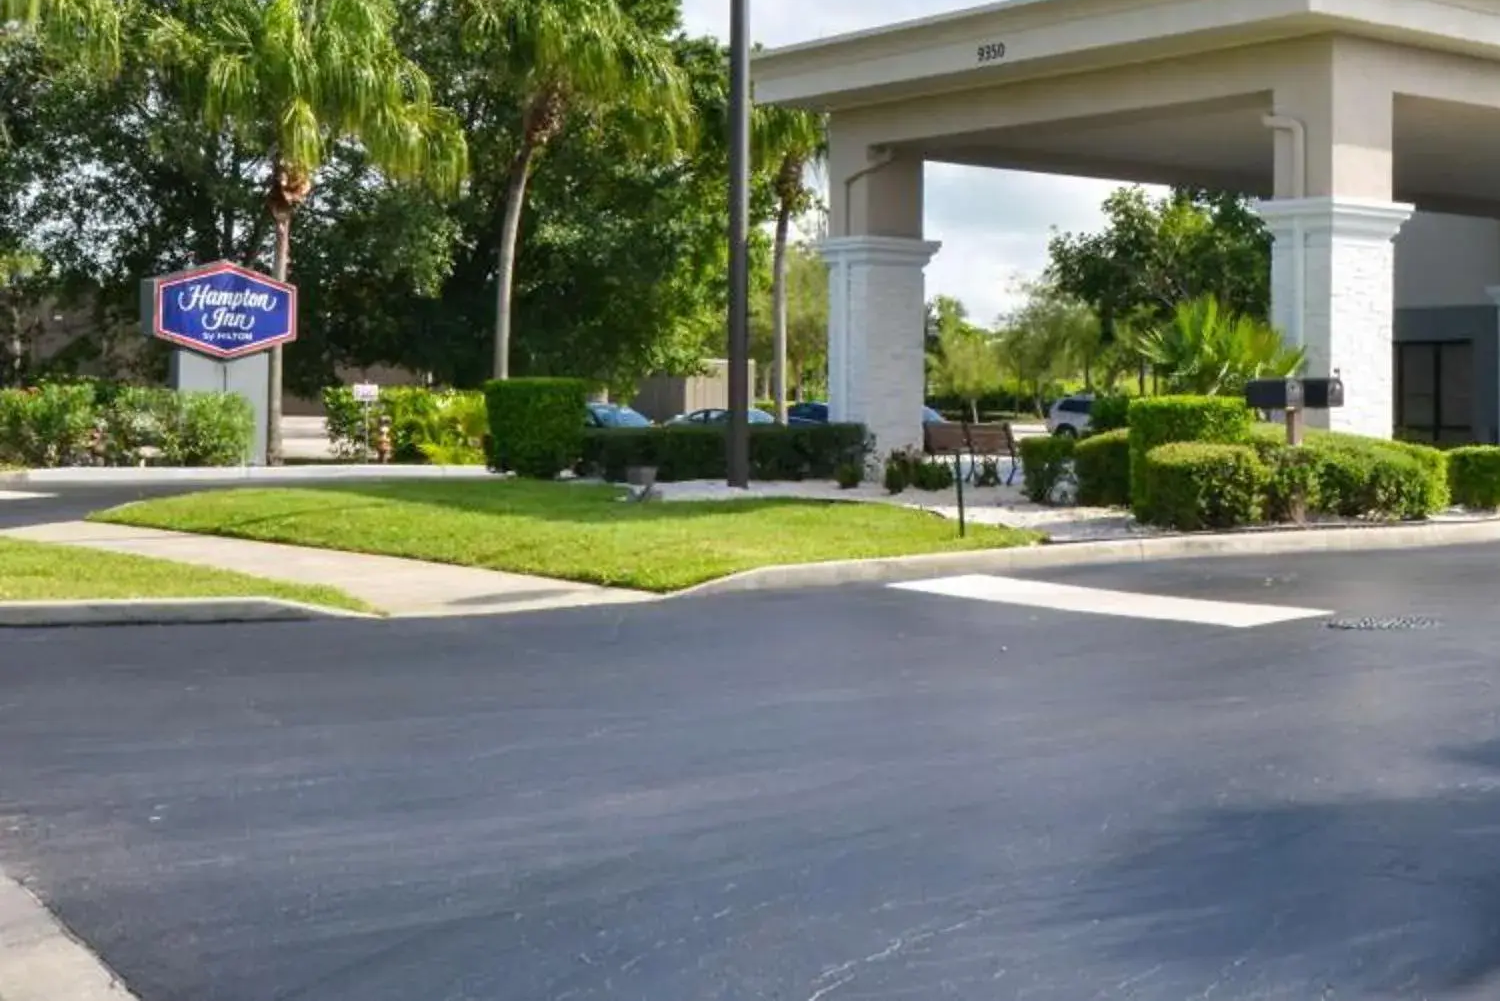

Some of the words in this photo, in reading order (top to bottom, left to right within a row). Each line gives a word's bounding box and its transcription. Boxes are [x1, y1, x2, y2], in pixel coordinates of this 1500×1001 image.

[977, 42, 1005, 62] 9350
[178, 283, 277, 311] Hampton
[201, 306, 255, 330] Inn
